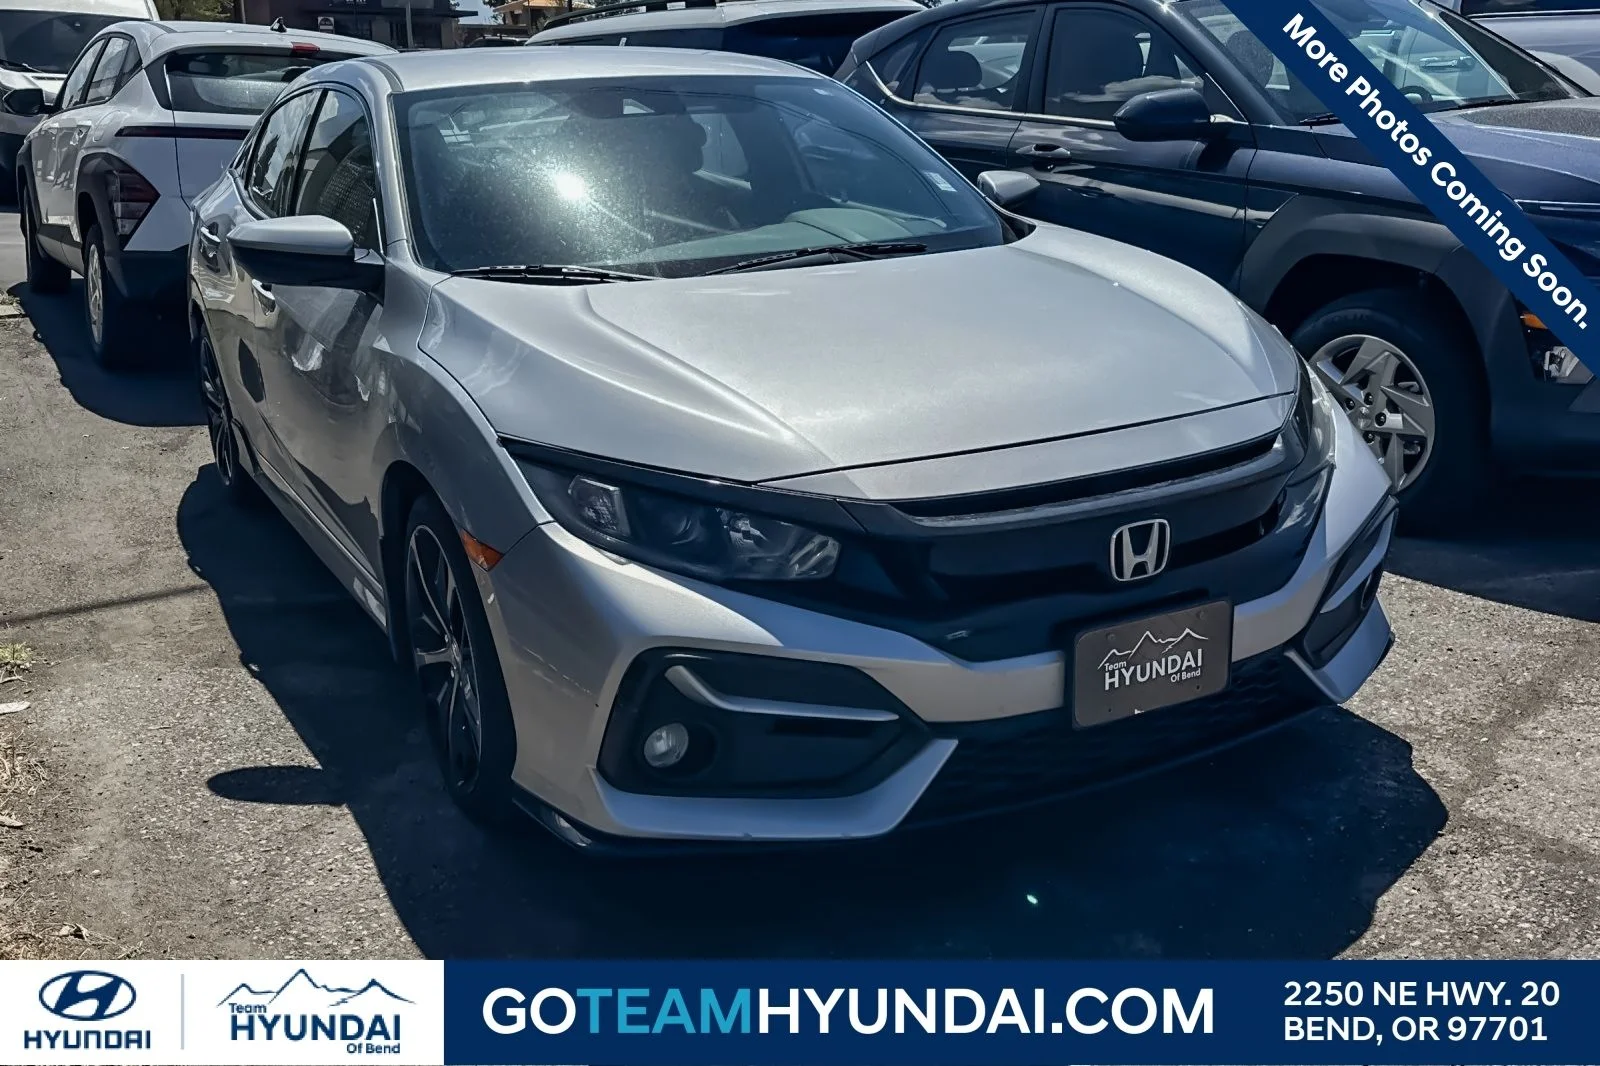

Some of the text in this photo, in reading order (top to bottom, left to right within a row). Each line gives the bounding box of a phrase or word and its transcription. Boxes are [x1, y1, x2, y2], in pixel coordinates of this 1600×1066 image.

[1104, 661, 1127, 672] Team
[1104, 649, 1203, 691] HYUNDAI
[1170, 668, 1201, 683] Of Bend
